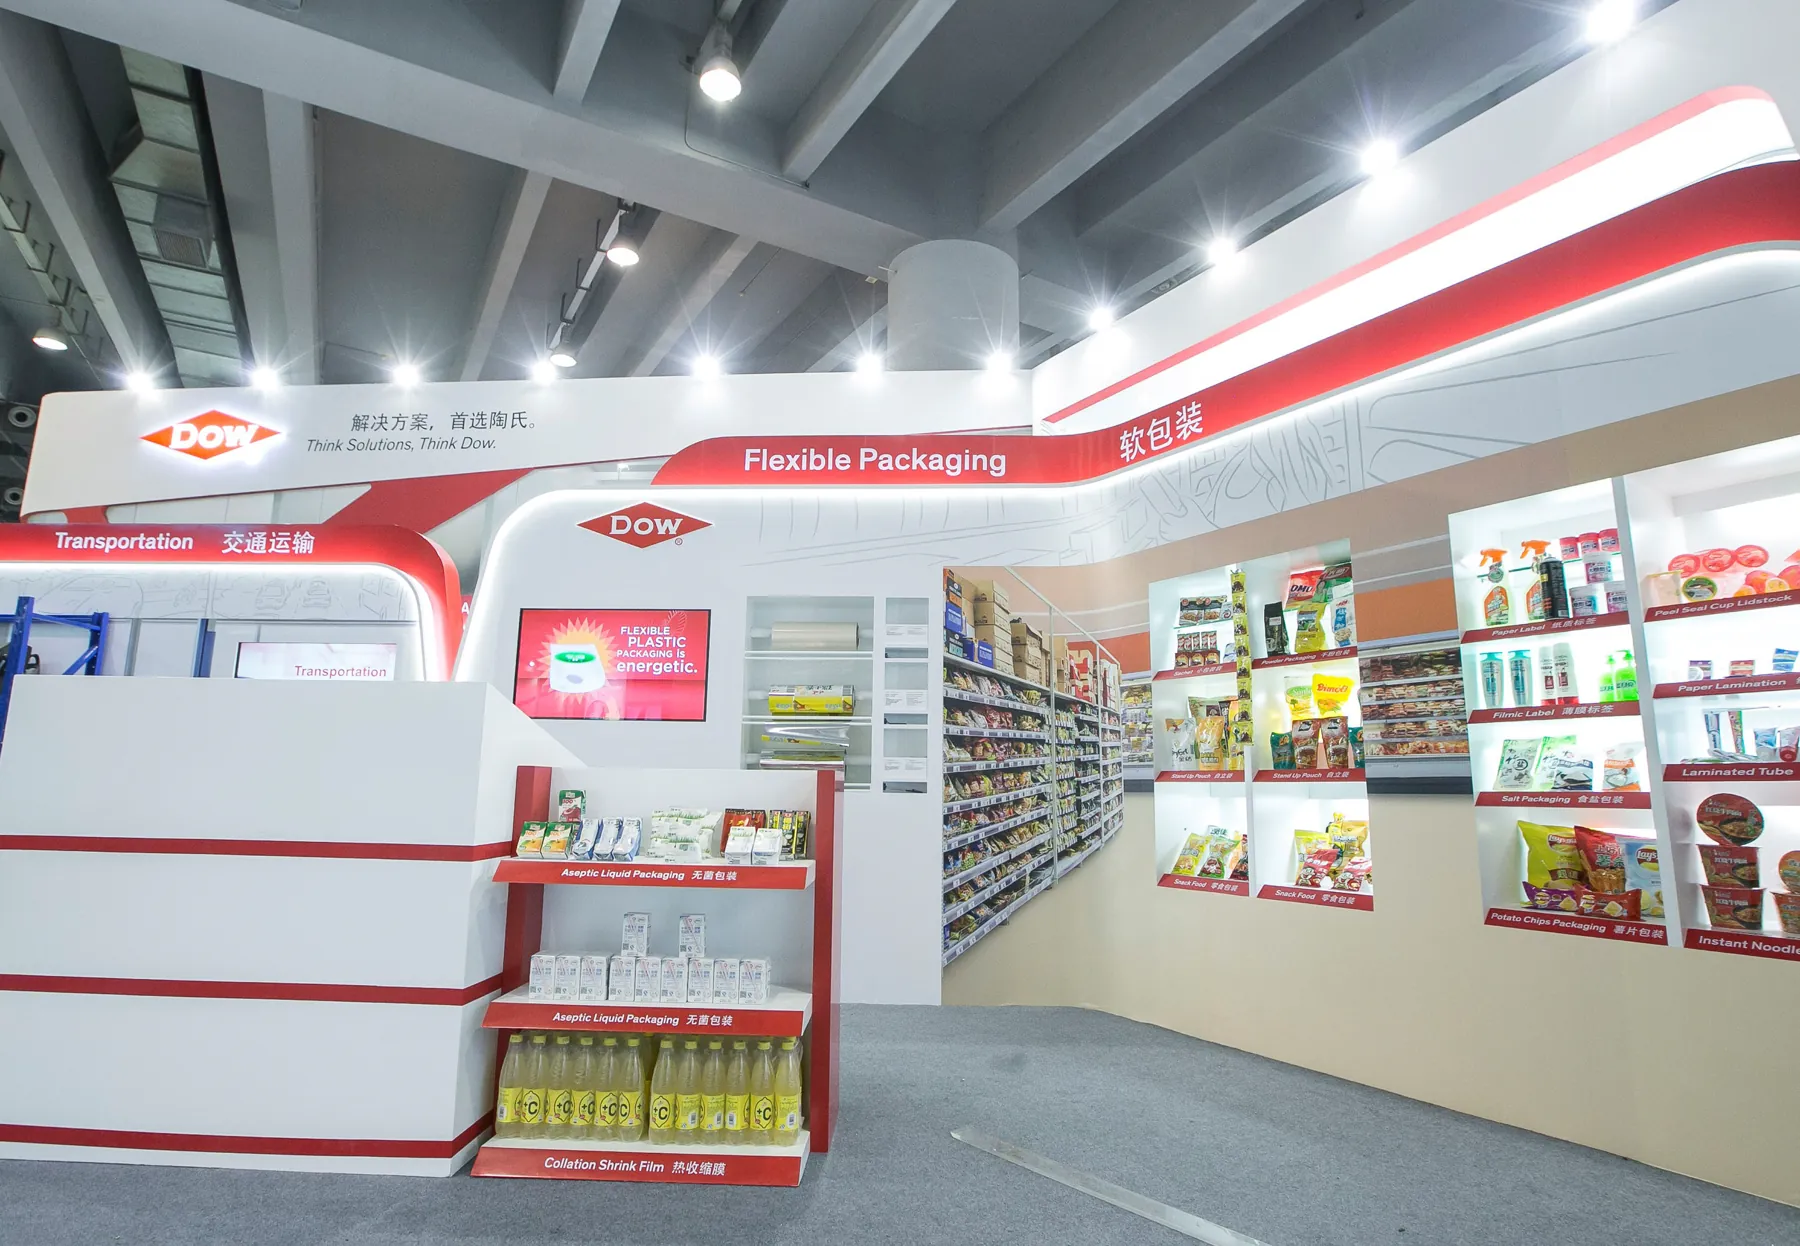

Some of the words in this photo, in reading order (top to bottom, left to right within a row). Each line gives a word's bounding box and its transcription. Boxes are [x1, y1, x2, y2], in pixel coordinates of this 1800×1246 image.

[1119, 401, 1204, 463] 软包装
[306, 438, 343, 453] Think
[346, 438, 414, 453] Solutions,
[418, 436, 457, 451] Think
[460, 436, 497, 450] Dow.
[744, 447, 851, 472] Flexible
[859, 448, 1007, 477] Packaging
[55, 531, 194, 553] Transportation
[221, 530, 316, 555] 交通运输
[1654, 607, 1680, 617] Peel
[1682, 604, 1708, 614] Seal
[1709, 601, 1735, 612] Cup
[1736, 594, 1793, 607] Lidstock
[620, 626, 671, 636] FLEXIBLE
[1492, 628, 1519, 637] Paper
[1519, 624, 1546, 633] Label
[627, 636, 687, 648] PLASTIC
[616, 649, 673, 659] PACKAGING
[676, 649, 686, 659] is
[294, 664, 387, 680] Transportation
[616, 659, 698, 676] energetic.
[1678, 684, 1714, 693] Paper
[1715, 679, 1787, 690] Lamination
[1492, 710, 1524, 719] Filmic
[1525, 709, 1555, 718] Label
[1682, 767, 1755, 777] Laminated
[1758, 767, 1794, 776] Tube
[1501, 795, 1520, 803] Salt
[1521, 795, 1571, 804] Packaging
[561, 868, 600, 879] Aseptic
[600, 868, 631, 879] Liquid
[632, 869, 685, 882] Packaging
[691, 870, 738, 882] 无菌包装
[1173, 878, 1191, 886] Snack
[1274, 889, 1296, 898] Snack
[1297, 892, 1317, 900] Food
[1490, 912, 1522, 922] Potato
[1523, 916, 1551, 926] Chips
[1552, 919, 1607, 934] Packaging
[1698, 935, 1749, 950] Instant
[553, 1012, 592, 1024] Aseptic
[593, 1013, 625, 1025] Liquid
[626, 1014, 680, 1026] Packaging
[685, 1014, 733, 1026] 无菌包装
[544, 1156, 597, 1171] Collation
[598, 1159, 637, 1172] Shrink
[638, 1160, 665, 1173] Film
[671, 1160, 727, 1177] 热收缩膜
